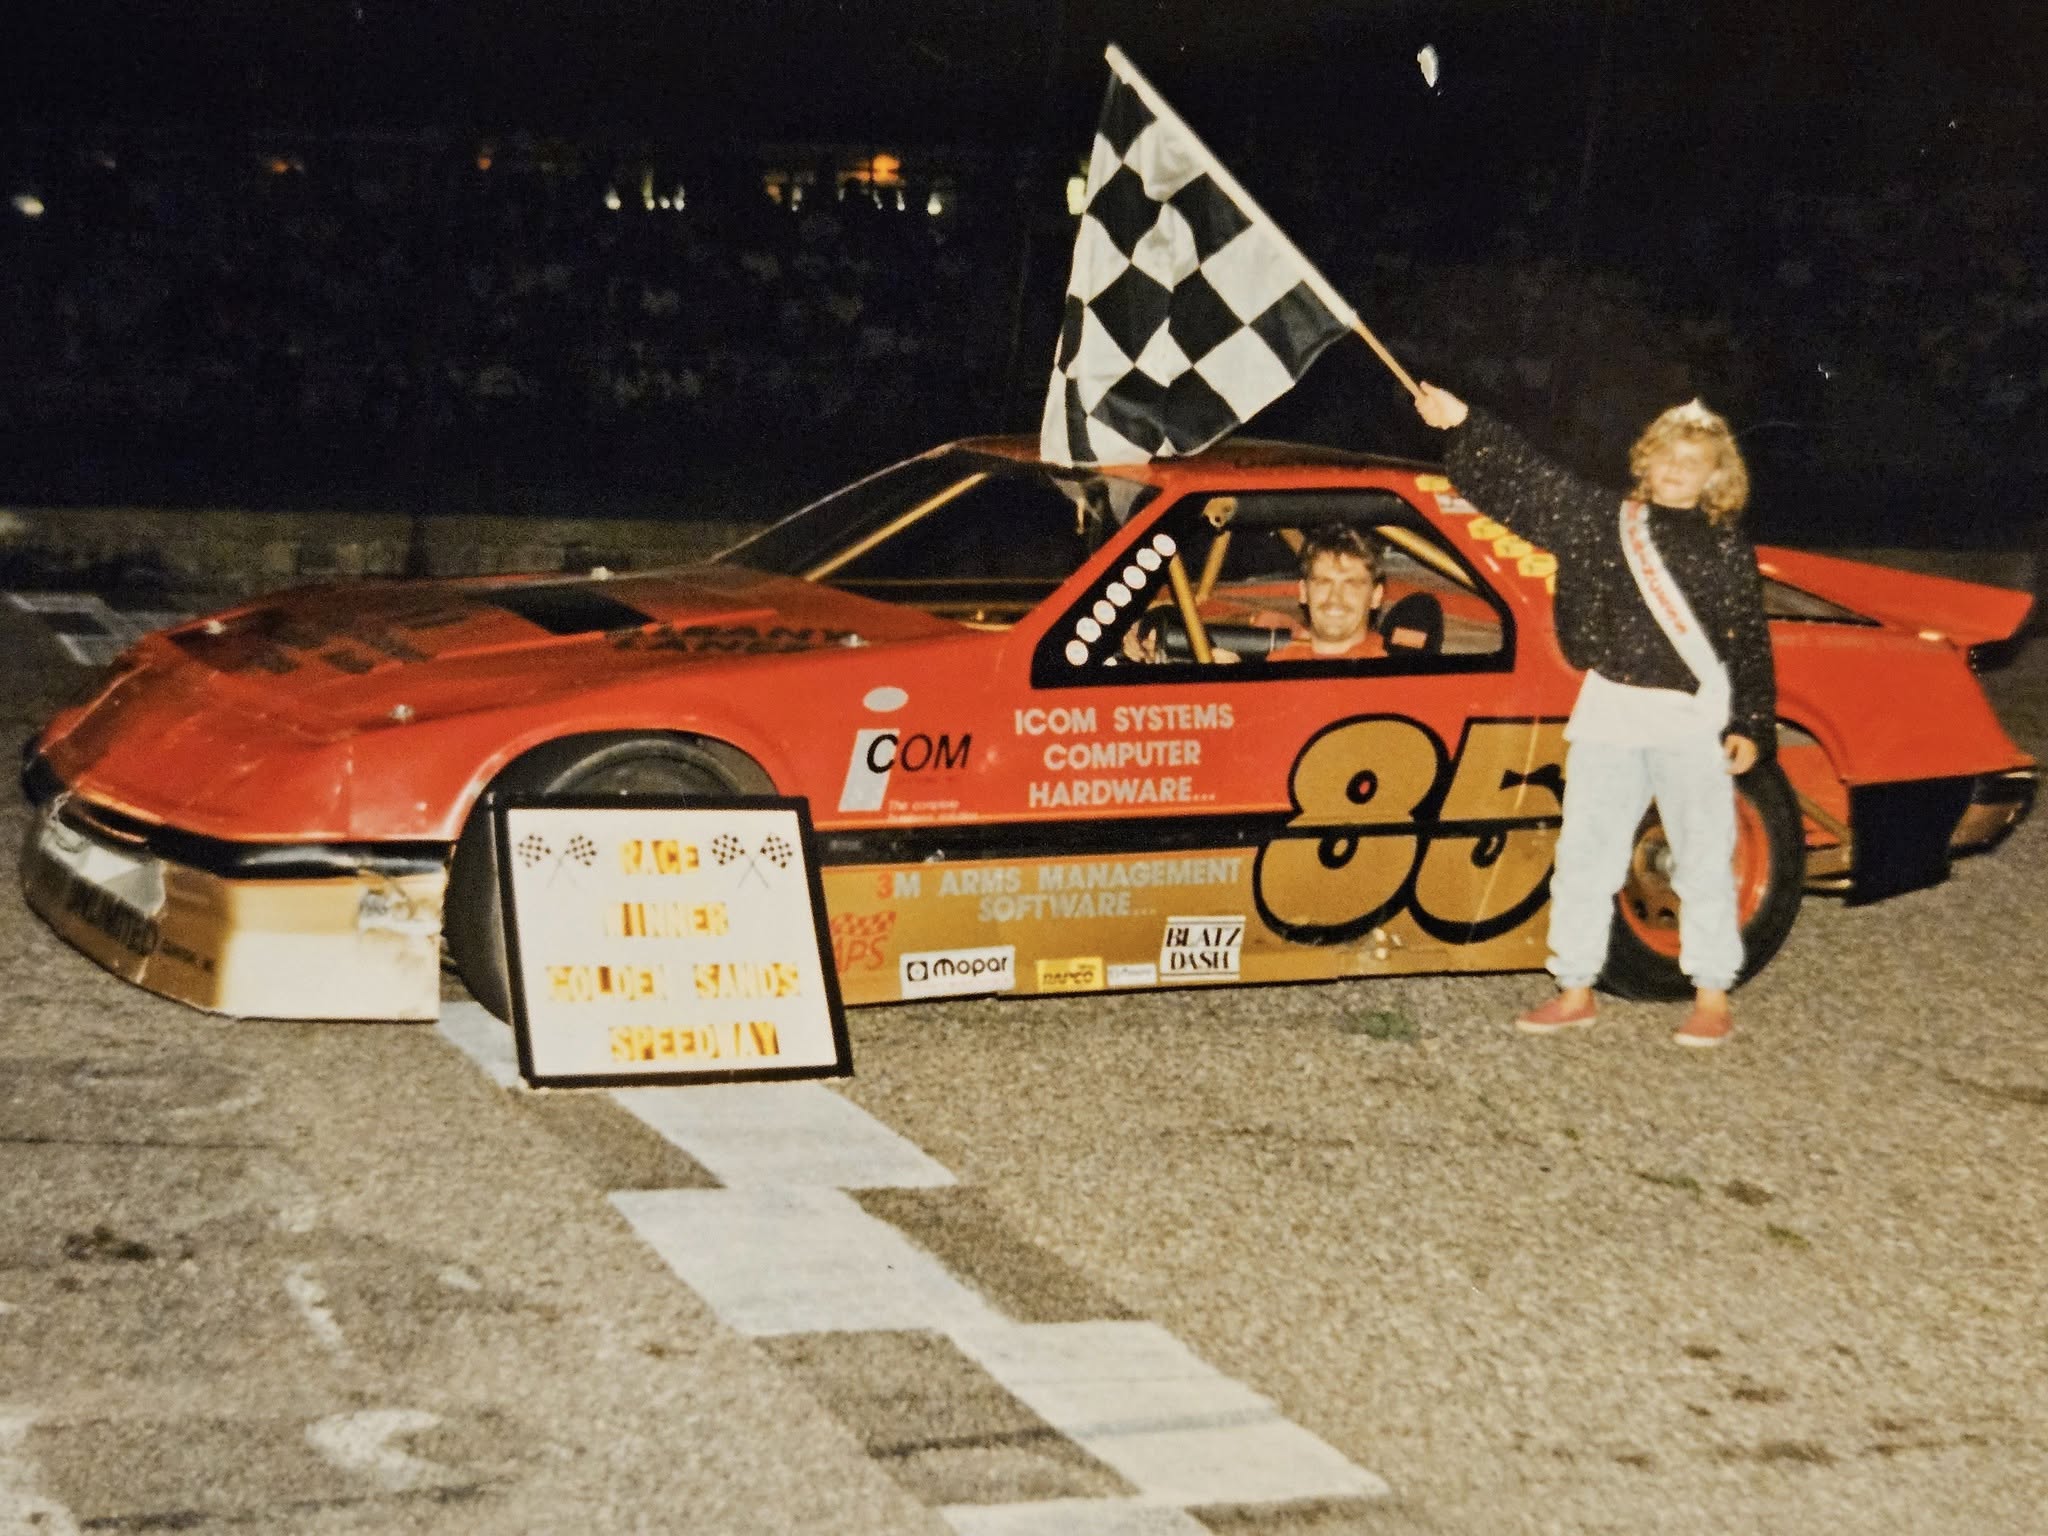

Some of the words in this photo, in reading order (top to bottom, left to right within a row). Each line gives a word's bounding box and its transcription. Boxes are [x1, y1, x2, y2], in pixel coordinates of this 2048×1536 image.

[1015, 707, 1097, 735] ICOM
[1113, 703, 1234, 732] SYSTEMS
[1043, 739, 1201, 771] COMPUTER
[1028, 776, 1216, 808] HARDWARE...
[1252, 712, 1571, 946] 85
[938, 866, 1021, 896] ARMS
[1038, 857, 1242, 891] MANAGEMENT
[1166, 927, 1242, 948] BLATZ
[1170, 951, 1229, 970] DASH
